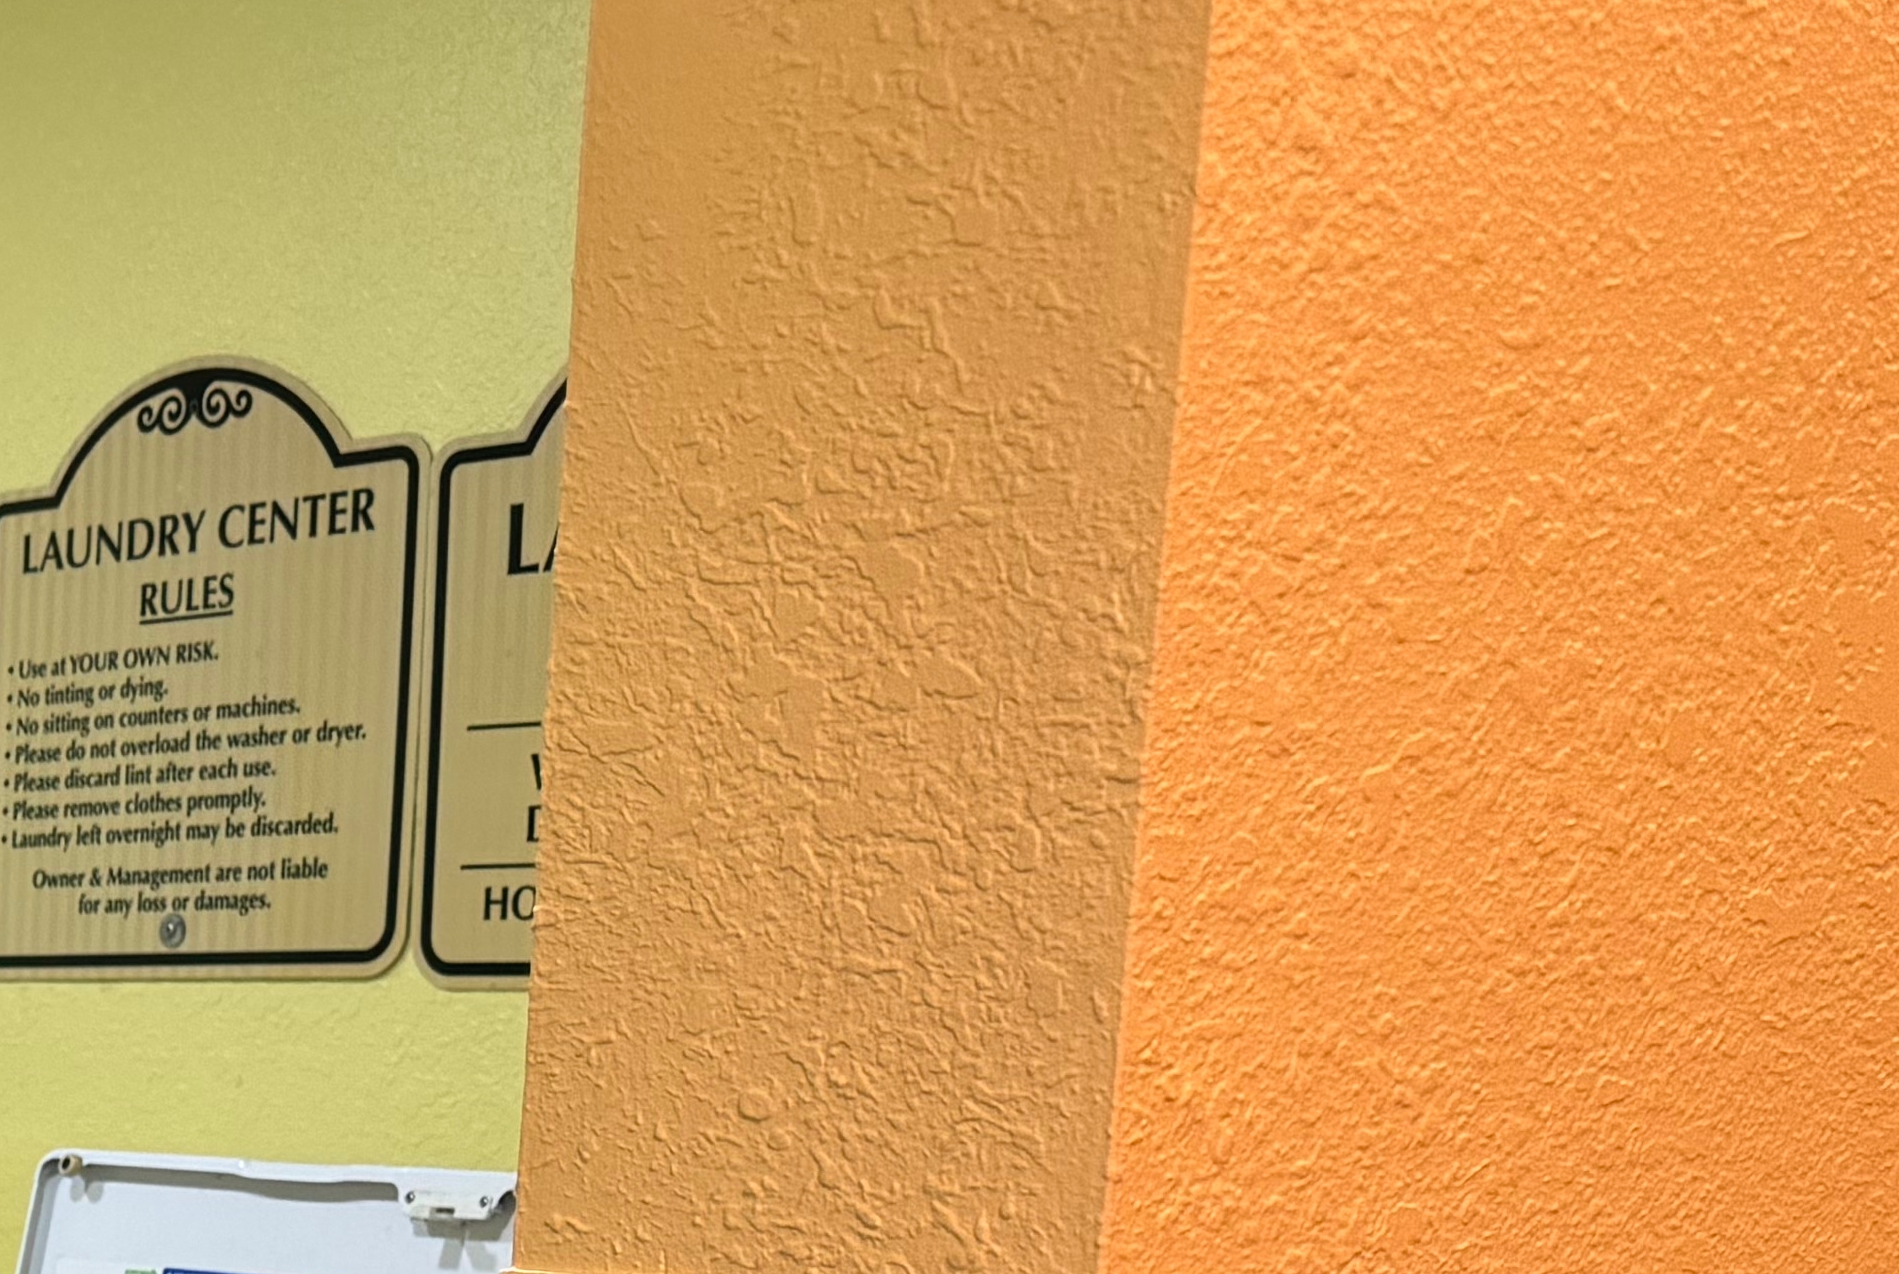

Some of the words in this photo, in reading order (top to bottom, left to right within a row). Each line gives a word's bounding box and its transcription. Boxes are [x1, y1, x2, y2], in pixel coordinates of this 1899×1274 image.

[22, 508, 206, 575] LAUNDRY
[218, 487, 376, 549] CENTER
[506, 502, 560, 575] L
[139, 572, 235, 618] RULES
[18, 658, 48, 680] Use
[51, 657, 67, 677] at
[69, 650, 119, 675] YOUR
[123, 644, 171, 670] OWN
[175, 639, 219, 665] RISK.
[16, 687, 41, 709] No
[44, 680, 95, 709] tinting
[98, 683, 117, 701] or
[119, 675, 169, 704] dying.
[15, 717, 40, 737] No
[42, 710, 91, 739] sitting
[93, 713, 115, 731] on
[118, 705, 189, 729] counters
[192, 704, 211, 723] or
[215, 692, 301, 721] machines.
[14, 743, 62, 765] Please
[65, 738, 86, 761] do
[89, 738, 117, 759] not
[119, 729, 191, 757] overload
[195, 728, 222, 751] the
[226, 723, 287, 750] washer
[291, 726, 312, 745] or
[316, 718, 367, 749] dryer.
[13, 771, 61, 793] Please
[64, 764, 121, 790] discard
[124, 763, 152, 786] lint
[155, 760, 194, 784] after
[198, 756, 238, 781] each
[242, 759, 277, 777] use.
[12, 800, 60, 821] Please
[63, 799, 122, 819] remove
[125, 790, 183, 815] clothes
[186, 784, 267, 818] promptly.
[11, 825, 72, 853] Laundry
[76, 823, 102, 846] left
[105, 819, 182, 849] overnight
[186, 822, 221, 847] may
[224, 816, 246, 839] be
[250, 811, 339, 838] discarded.
[31, 868, 87, 890] Owner
[88, 866, 102, 888] &
[106, 862, 211, 892] Management
[214, 865, 243, 883] are
[246, 860, 276, 882] not
[279, 855, 329, 881] liable
[78, 892, 102, 916] for
[104, 896, 134, 921] any
[136, 890, 168, 914] loss
[171, 896, 191, 914] or
[194, 889, 272, 918] damages.
